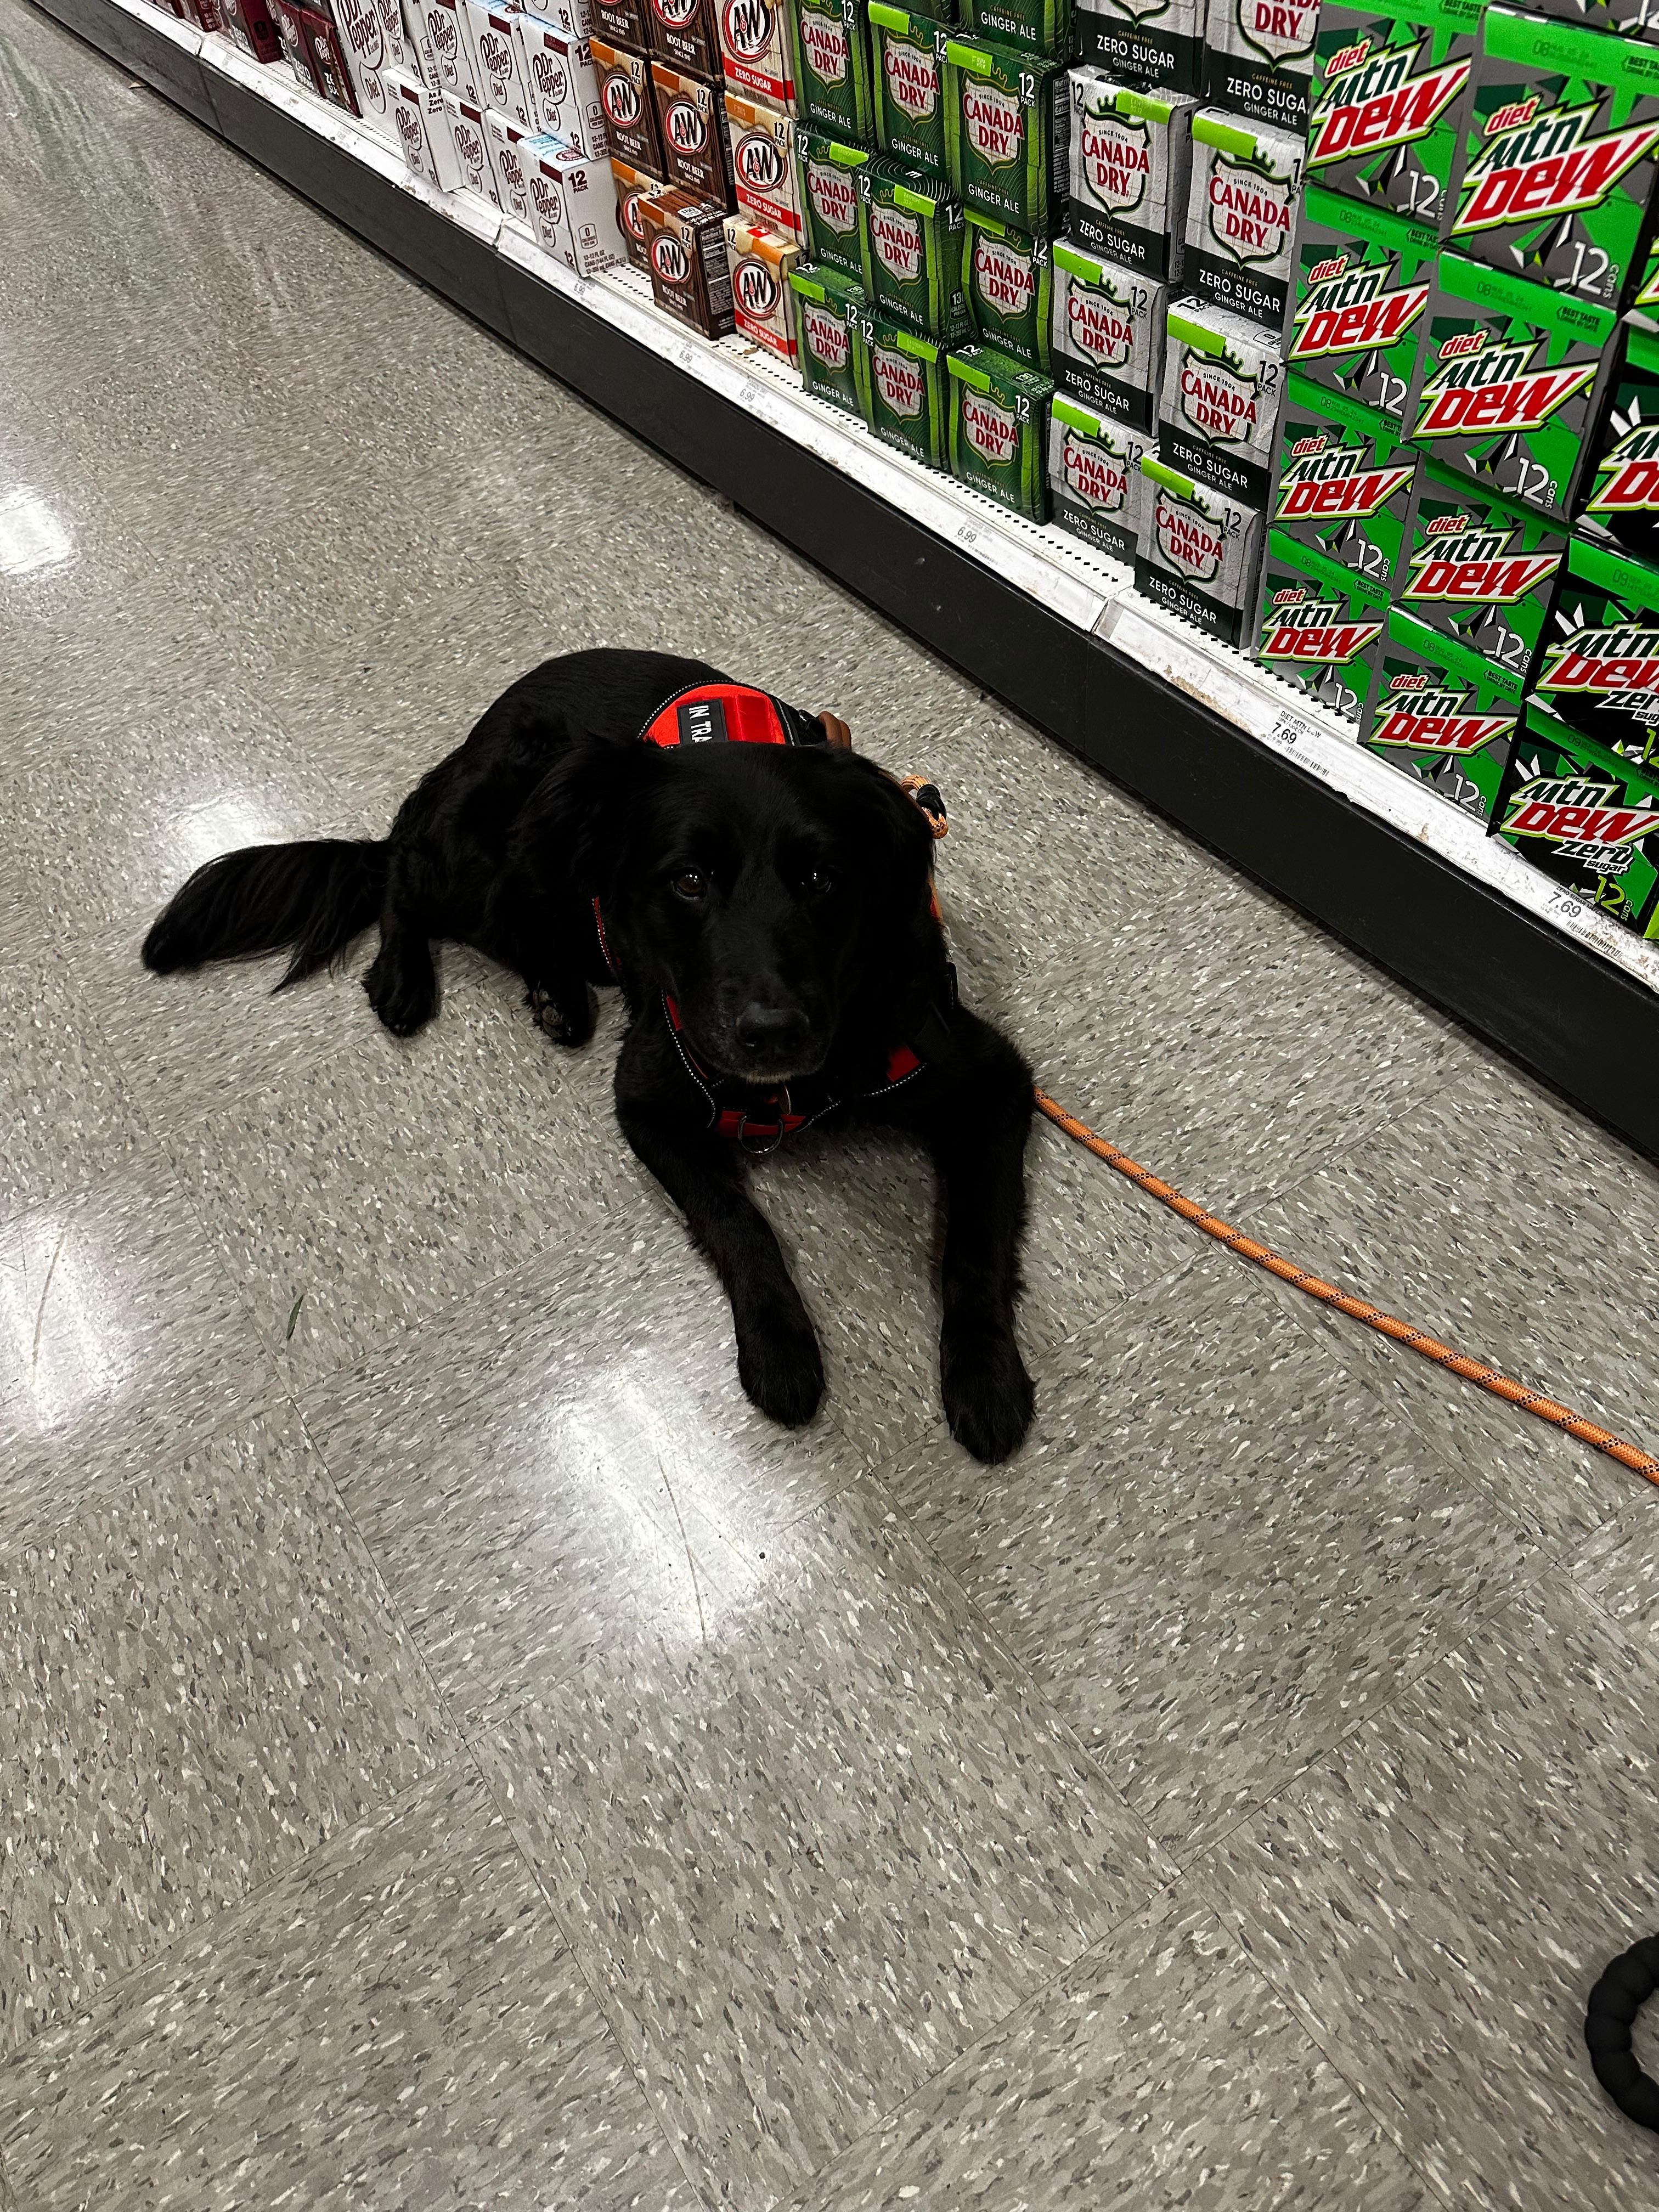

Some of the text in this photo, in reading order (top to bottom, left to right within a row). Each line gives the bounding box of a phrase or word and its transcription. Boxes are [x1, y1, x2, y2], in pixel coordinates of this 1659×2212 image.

[981, 12, 1036, 41] GINGER ALE
[1255, 2, 1303, 40] DRY
[667, 33, 696, 55] ROOT BEER
[800, 20, 850, 60] CANADA
[1097, 35, 1175, 69] ZERO SUGAR
[814, 49, 839, 76] DRY
[884, 50, 939, 94] CANADA
[1113, 57, 1159, 78] GINGER ALE
[1327, 42, 1368, 75] diet
[735, 67, 771, 92] ZERO SUGAR
[1019, 72, 1035, 98] 12
[1319, 55, 1407, 113] Mtn
[611, 83, 633, 119] A&W
[899, 82, 927, 109] DRY
[674, 111, 698, 146] A&W
[963, 94, 1024, 139] CANADA
[1487, 99, 1536, 132] diet
[891, 138, 939, 166] GINGER ALE
[978, 125, 1009, 155] DRY
[1082, 129, 1150, 174] CANADA
[1473, 115, 1582, 176] Mtn
[747, 145, 773, 182] A&W
[568, 170, 587, 187] 12
[573, 184, 588, 193] PACK
[808, 172, 858, 206] CANADA
[1097, 162, 1131, 197] DRY
[746, 194, 782, 219] ZERO SUGAR
[968, 184, 1019, 214] GINGER ALE
[1210, 176, 1290, 232] CANADA
[1410, 170, 1440, 218] 12
[822, 198, 847, 222] DRY
[870, 215, 923, 256] CANADA
[1080, 219, 1146, 260] ZERO SUGAR
[1226, 212, 1268, 248] DRY
[883, 242, 911, 269] DRY
[1311, 258, 1346, 281] diet
[1572, 241, 1609, 295] 12
[975, 249, 1035, 296] CANADA
[743, 271, 767, 307] A&W
[989, 278, 1019, 307] DRY
[1131, 286, 1148, 311] 12
[1199, 269, 1280, 312] ZERO SUGAR
[1302, 273, 1380, 314] Mtn
[1215, 292, 1263, 318] GINGER ALE
[804, 314, 850, 352] CANADA
[1068, 297, 1133, 346] CANADA
[816, 338, 839, 362] DRY
[1082, 326, 1116, 358] DRY
[1442, 334, 1485, 357] diet
[873, 356, 926, 396] CANADA
[1203, 373, 1235, 391] SINCE 1904
[1259, 360, 1279, 388] 12
[1431, 351, 1523, 391] Mtn
[740, 388, 755, 402] 6.99
[887, 381, 913, 407] DRY
[1065, 369, 1129, 411] ZERO SUGAR
[1181, 369, 1257, 424] CANADA
[1257, 383, 1276, 397] PACK
[1321, 396, 1331, 409] 08
[1380, 372, 1407, 415] 12
[1015, 396, 1030, 417] 12
[1016, 413, 1030, 425] PACK
[1196, 403, 1237, 436] DRY
[962, 401, 1019, 447] CANADA
[975, 428, 1004, 455] DRY
[1293, 438, 1325, 454] diet
[1064, 446, 1127, 495] CANADA
[1173, 443, 1248, 489] ZERO SUGAR
[1188, 463, 1232, 490] GINGER ALE
[1286, 452, 1357, 483] Mtn
[1517, 457, 1549, 504] 12
[966, 472, 1014, 503] GINGER ALE
[1078, 477, 1111, 503] DRY
[1545, 481, 1557, 509] cans
[1064, 510, 1125, 551] ZERO SUGAR
[1156, 506, 1223, 562] CANADA
[1225, 508, 1242, 532] 12
[1428, 517, 1467, 533] diet
[957, 527, 977, 543] 6.99
[1418, 533, 1503, 561] Mtn
[1170, 534, 1205, 569] DRY
[1358, 539, 1383, 578] 12
[1380, 558, 1390, 582] cans
[1149, 576, 1217, 624] ZERO SUGAR
[1161, 596, 1203, 624] GINGER ALE
[1274, 590, 1305, 603] diet
[1269, 603, 1333, 627] Mtn
[1423, 640, 1435, 652] 08
[1495, 626, 1525, 669] 12
[1520, 648, 1532, 673] cans
[1391, 675, 1425, 689] diet
[1488, 670, 1518, 690] BEST TASTE
[689, 705, 710, 719] IN
[1335, 682, 1357, 718] 12
[1384, 689, 1459, 716] Mtn
[1272, 722, 1297, 744] 7.69
[1280, 710, 1306, 730] DIET MTN
[1454, 774, 1480, 811] 12
[1477, 796, 1486, 816] cans
[1519, 781, 1606, 808] Mtn
[1558, 840, 1632, 864] zero
[1587, 860, 1626, 873] sugar
[1548, 891, 1582, 918] 7.69
[1595, 875, 1624, 916] 12
[1621, 899, 1633, 921] cans
